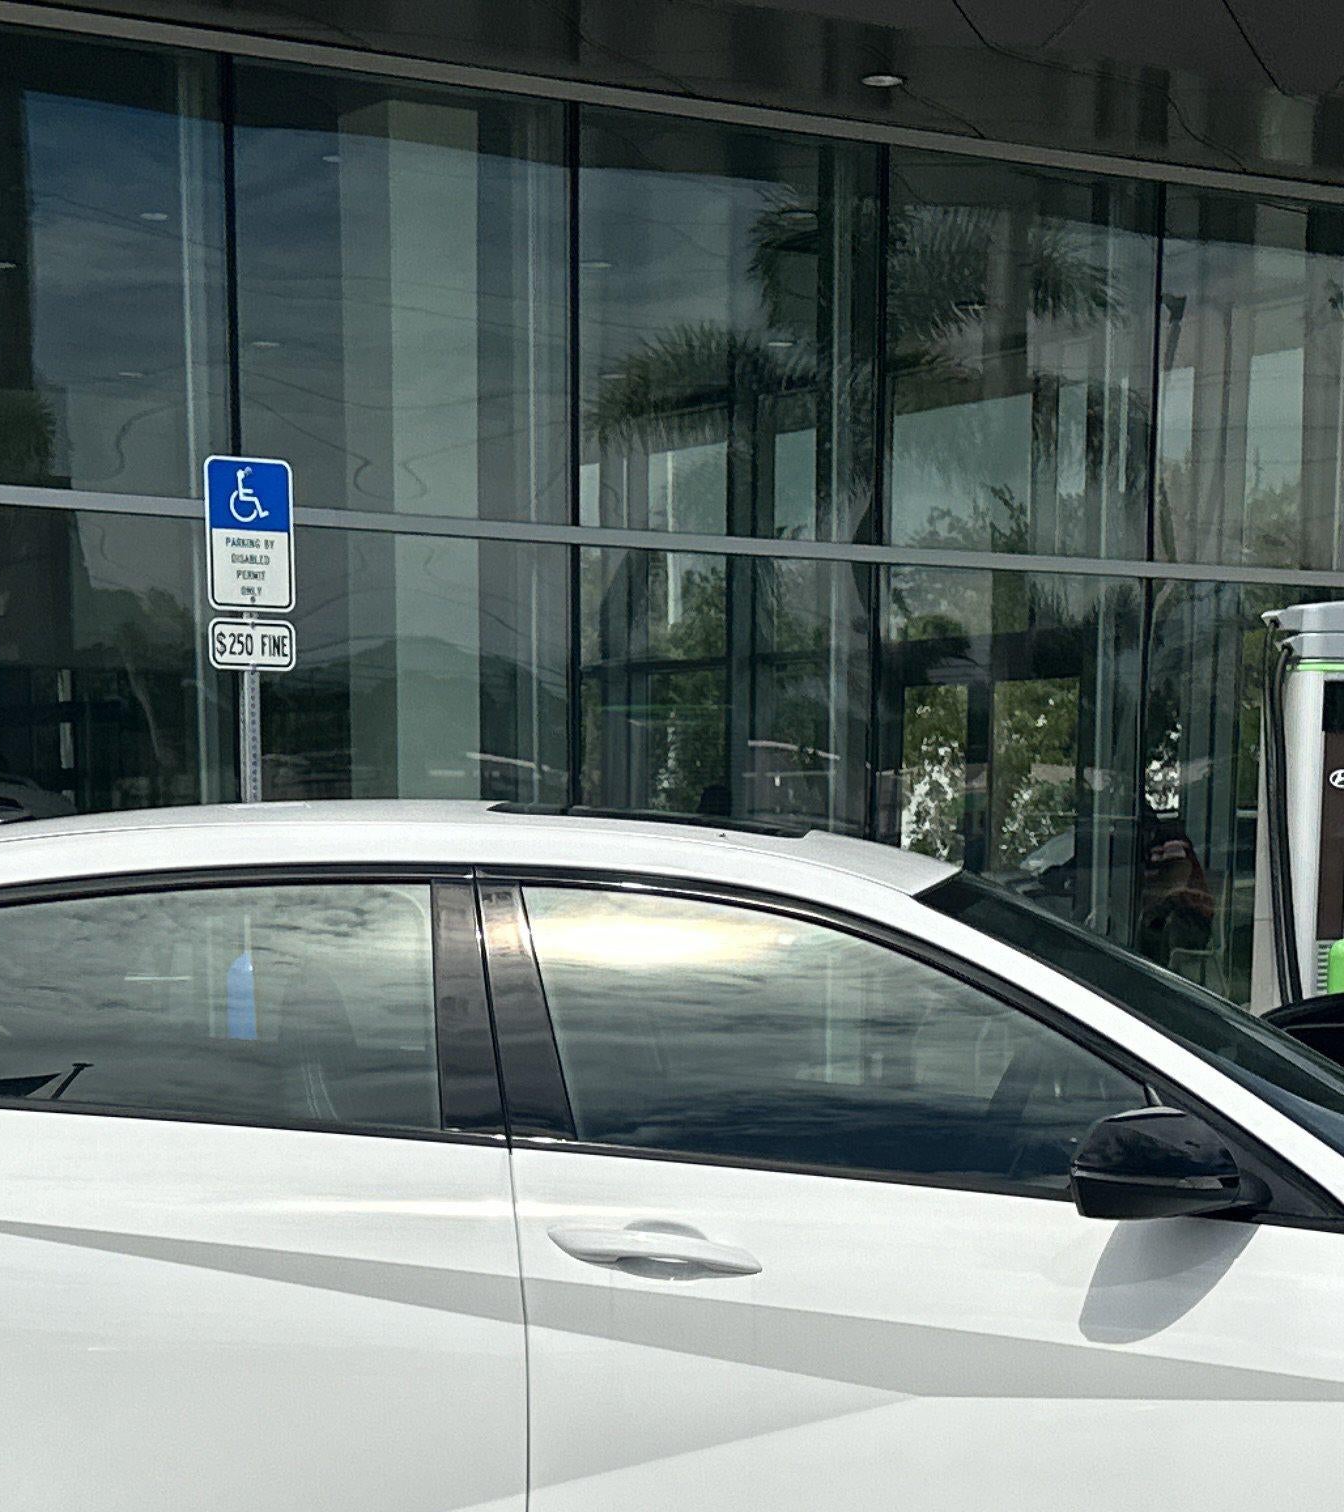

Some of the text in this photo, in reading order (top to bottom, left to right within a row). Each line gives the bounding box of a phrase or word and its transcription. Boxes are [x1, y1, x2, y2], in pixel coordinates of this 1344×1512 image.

[225, 536, 275, 550] PARKING BY
[231, 553, 270, 566] DISABLED
[236, 569, 266, 581] PERMIT
[216, 631, 289, 657] $250 FINE
